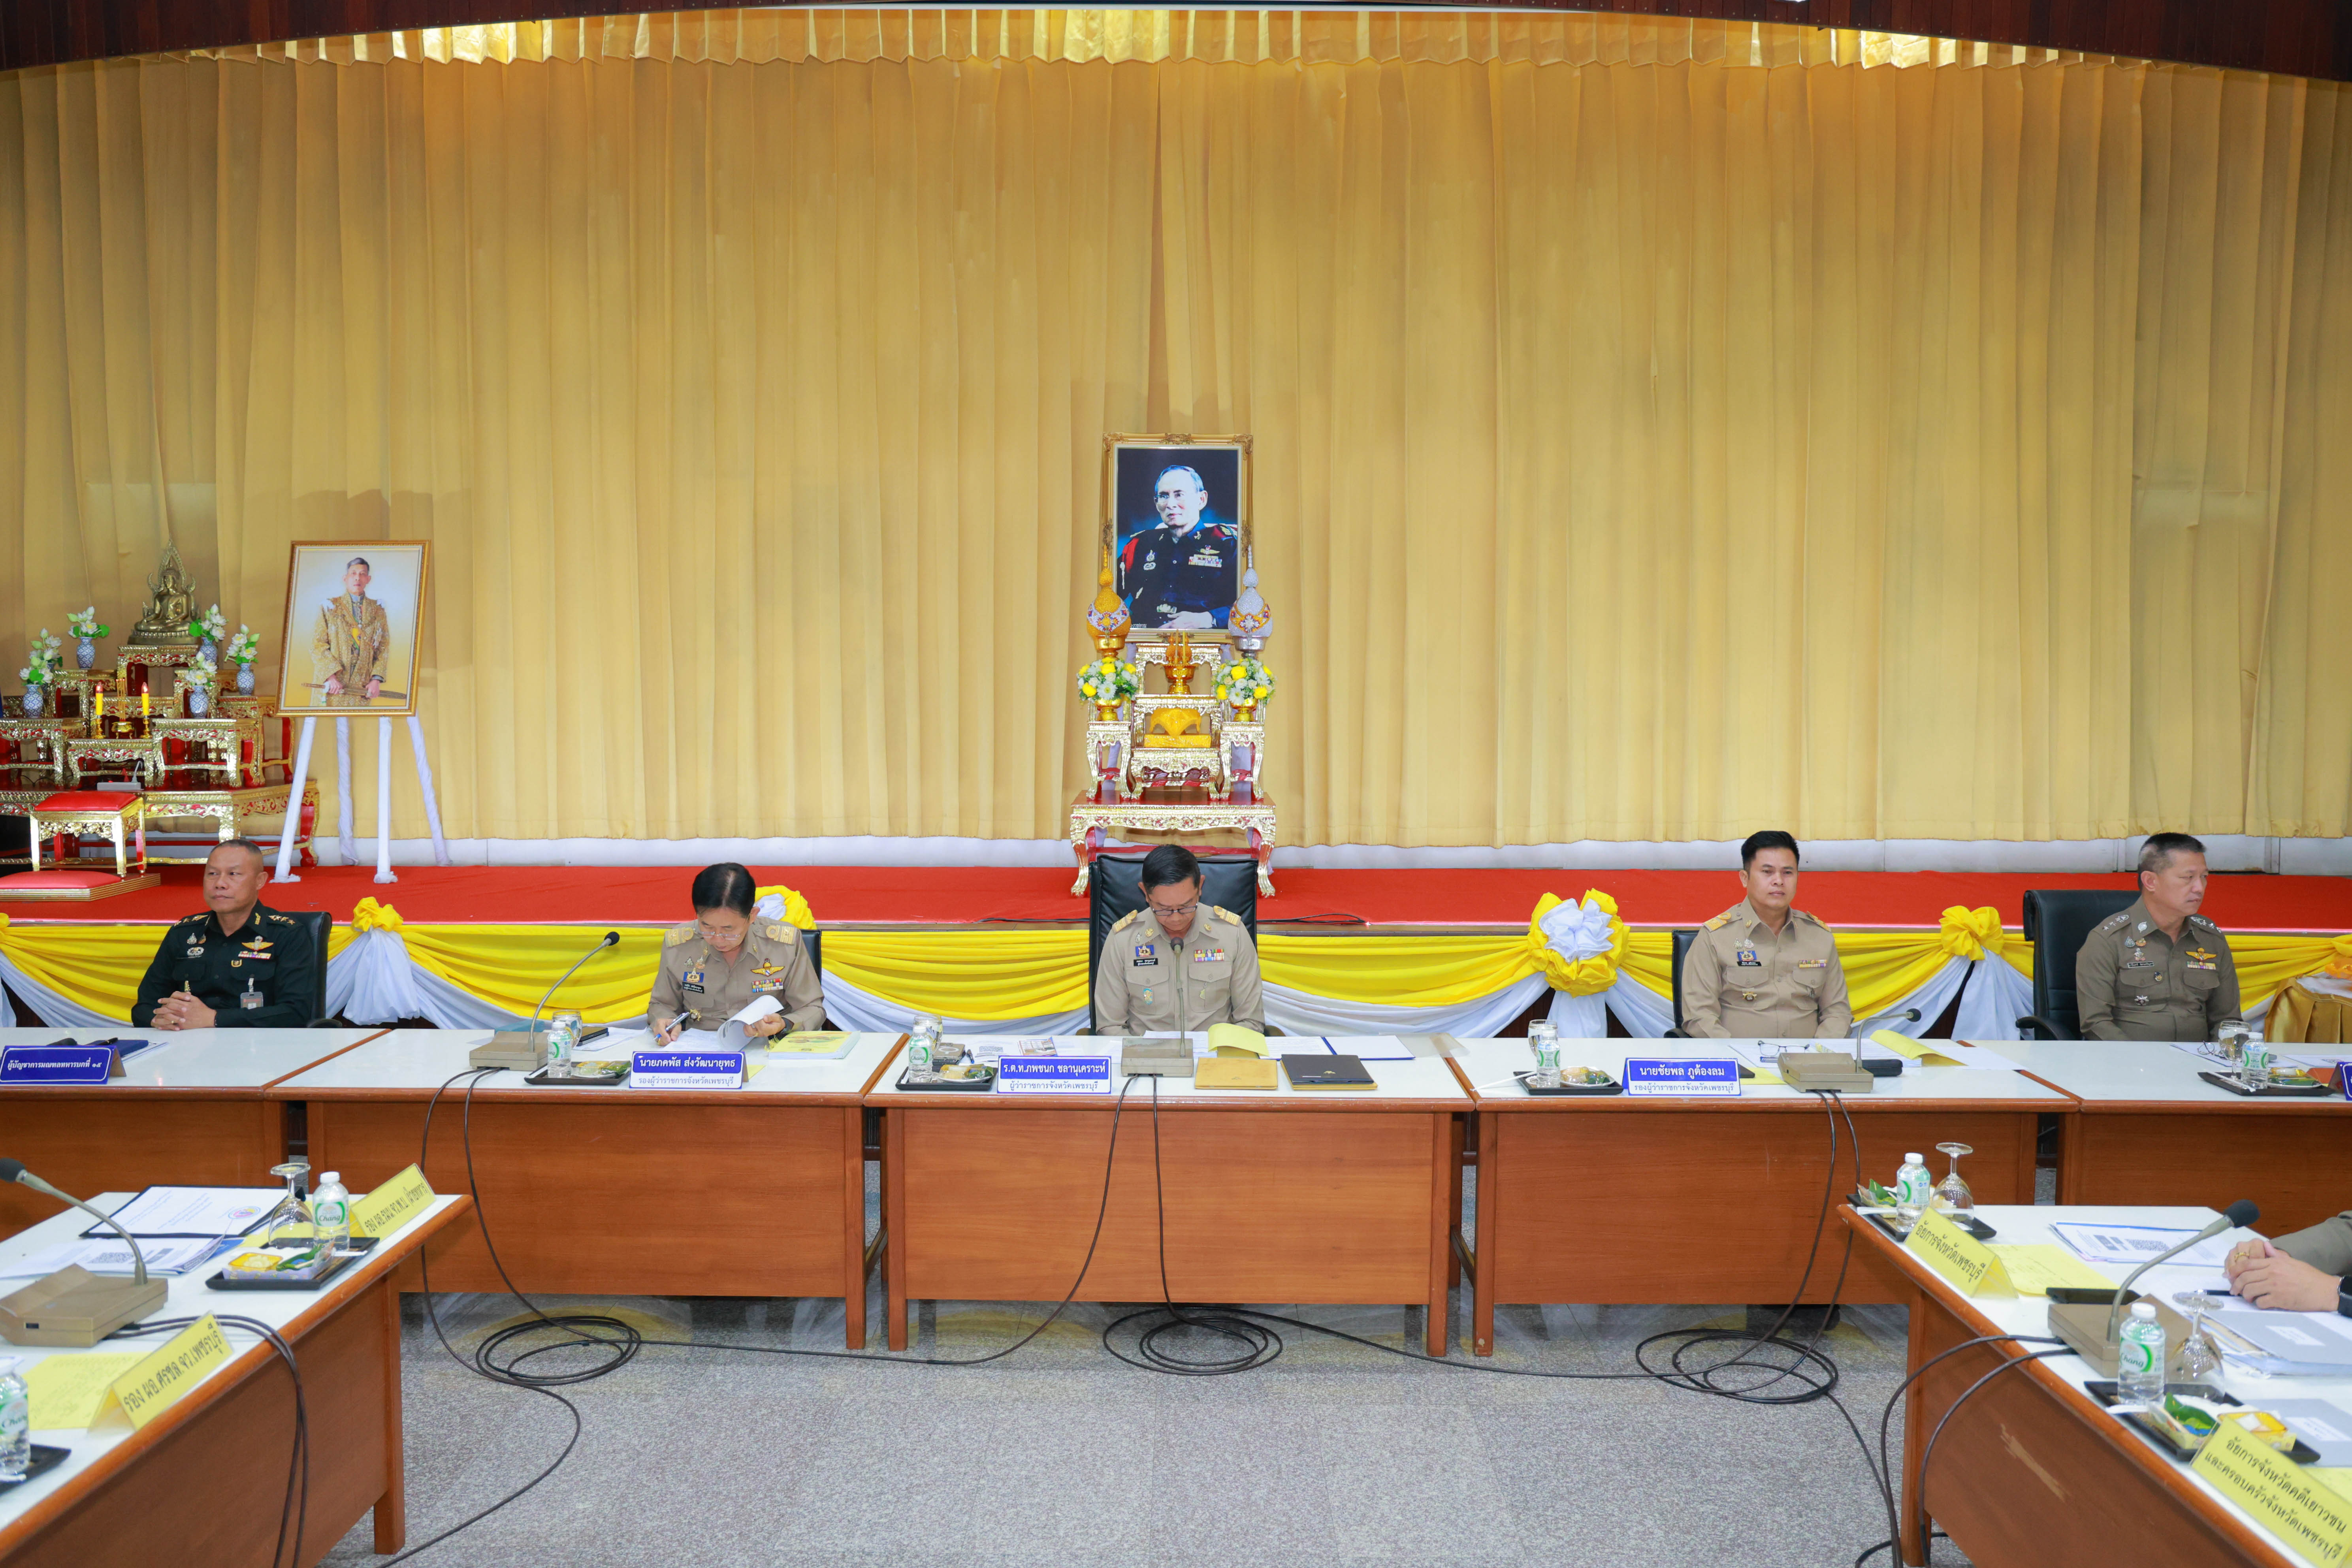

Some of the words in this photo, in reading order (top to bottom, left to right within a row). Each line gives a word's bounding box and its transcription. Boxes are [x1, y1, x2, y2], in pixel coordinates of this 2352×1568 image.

[8, 1057, 90, 1070] ผู้บัญชาการมณฑลทหารบกที่
[640, 1056, 681, 1067] นายภคพัส
[684, 1056, 736, 1071] ส่งวัฒนายุทธ
[1004, 1064, 1055, 1073] ร.ต.ท.ภพชนก
[1057, 1060, 1106, 1076] ชลานุเคราะห์
[1640, 1064, 1684, 1075] นายชัยพล
[1687, 1064, 1725, 1079] ภูต้องลม
[638, 1076, 734, 1086] รองผู้ว่าราชการจังหวัดเพชรบุรี
[1010, 1080, 1098, 1092] ผู้ว่าราชการจังหวัดเพชรบุรี
[1635, 1082, 1734, 1094] รองผู้ว่าราชการจังหวัดเพชรบุรี
[1916, 1220, 1986, 1283] อัยการจังหวัดเพชรบุรี
[124, 1388, 145, 1412] รอง
[2226, 1436, 2347, 1534] อัยการจังหวัดคดีเยาวชน
[2205, 1453, 2342, 1559] และครอบครัวจังหวัดเพชรบุรี
